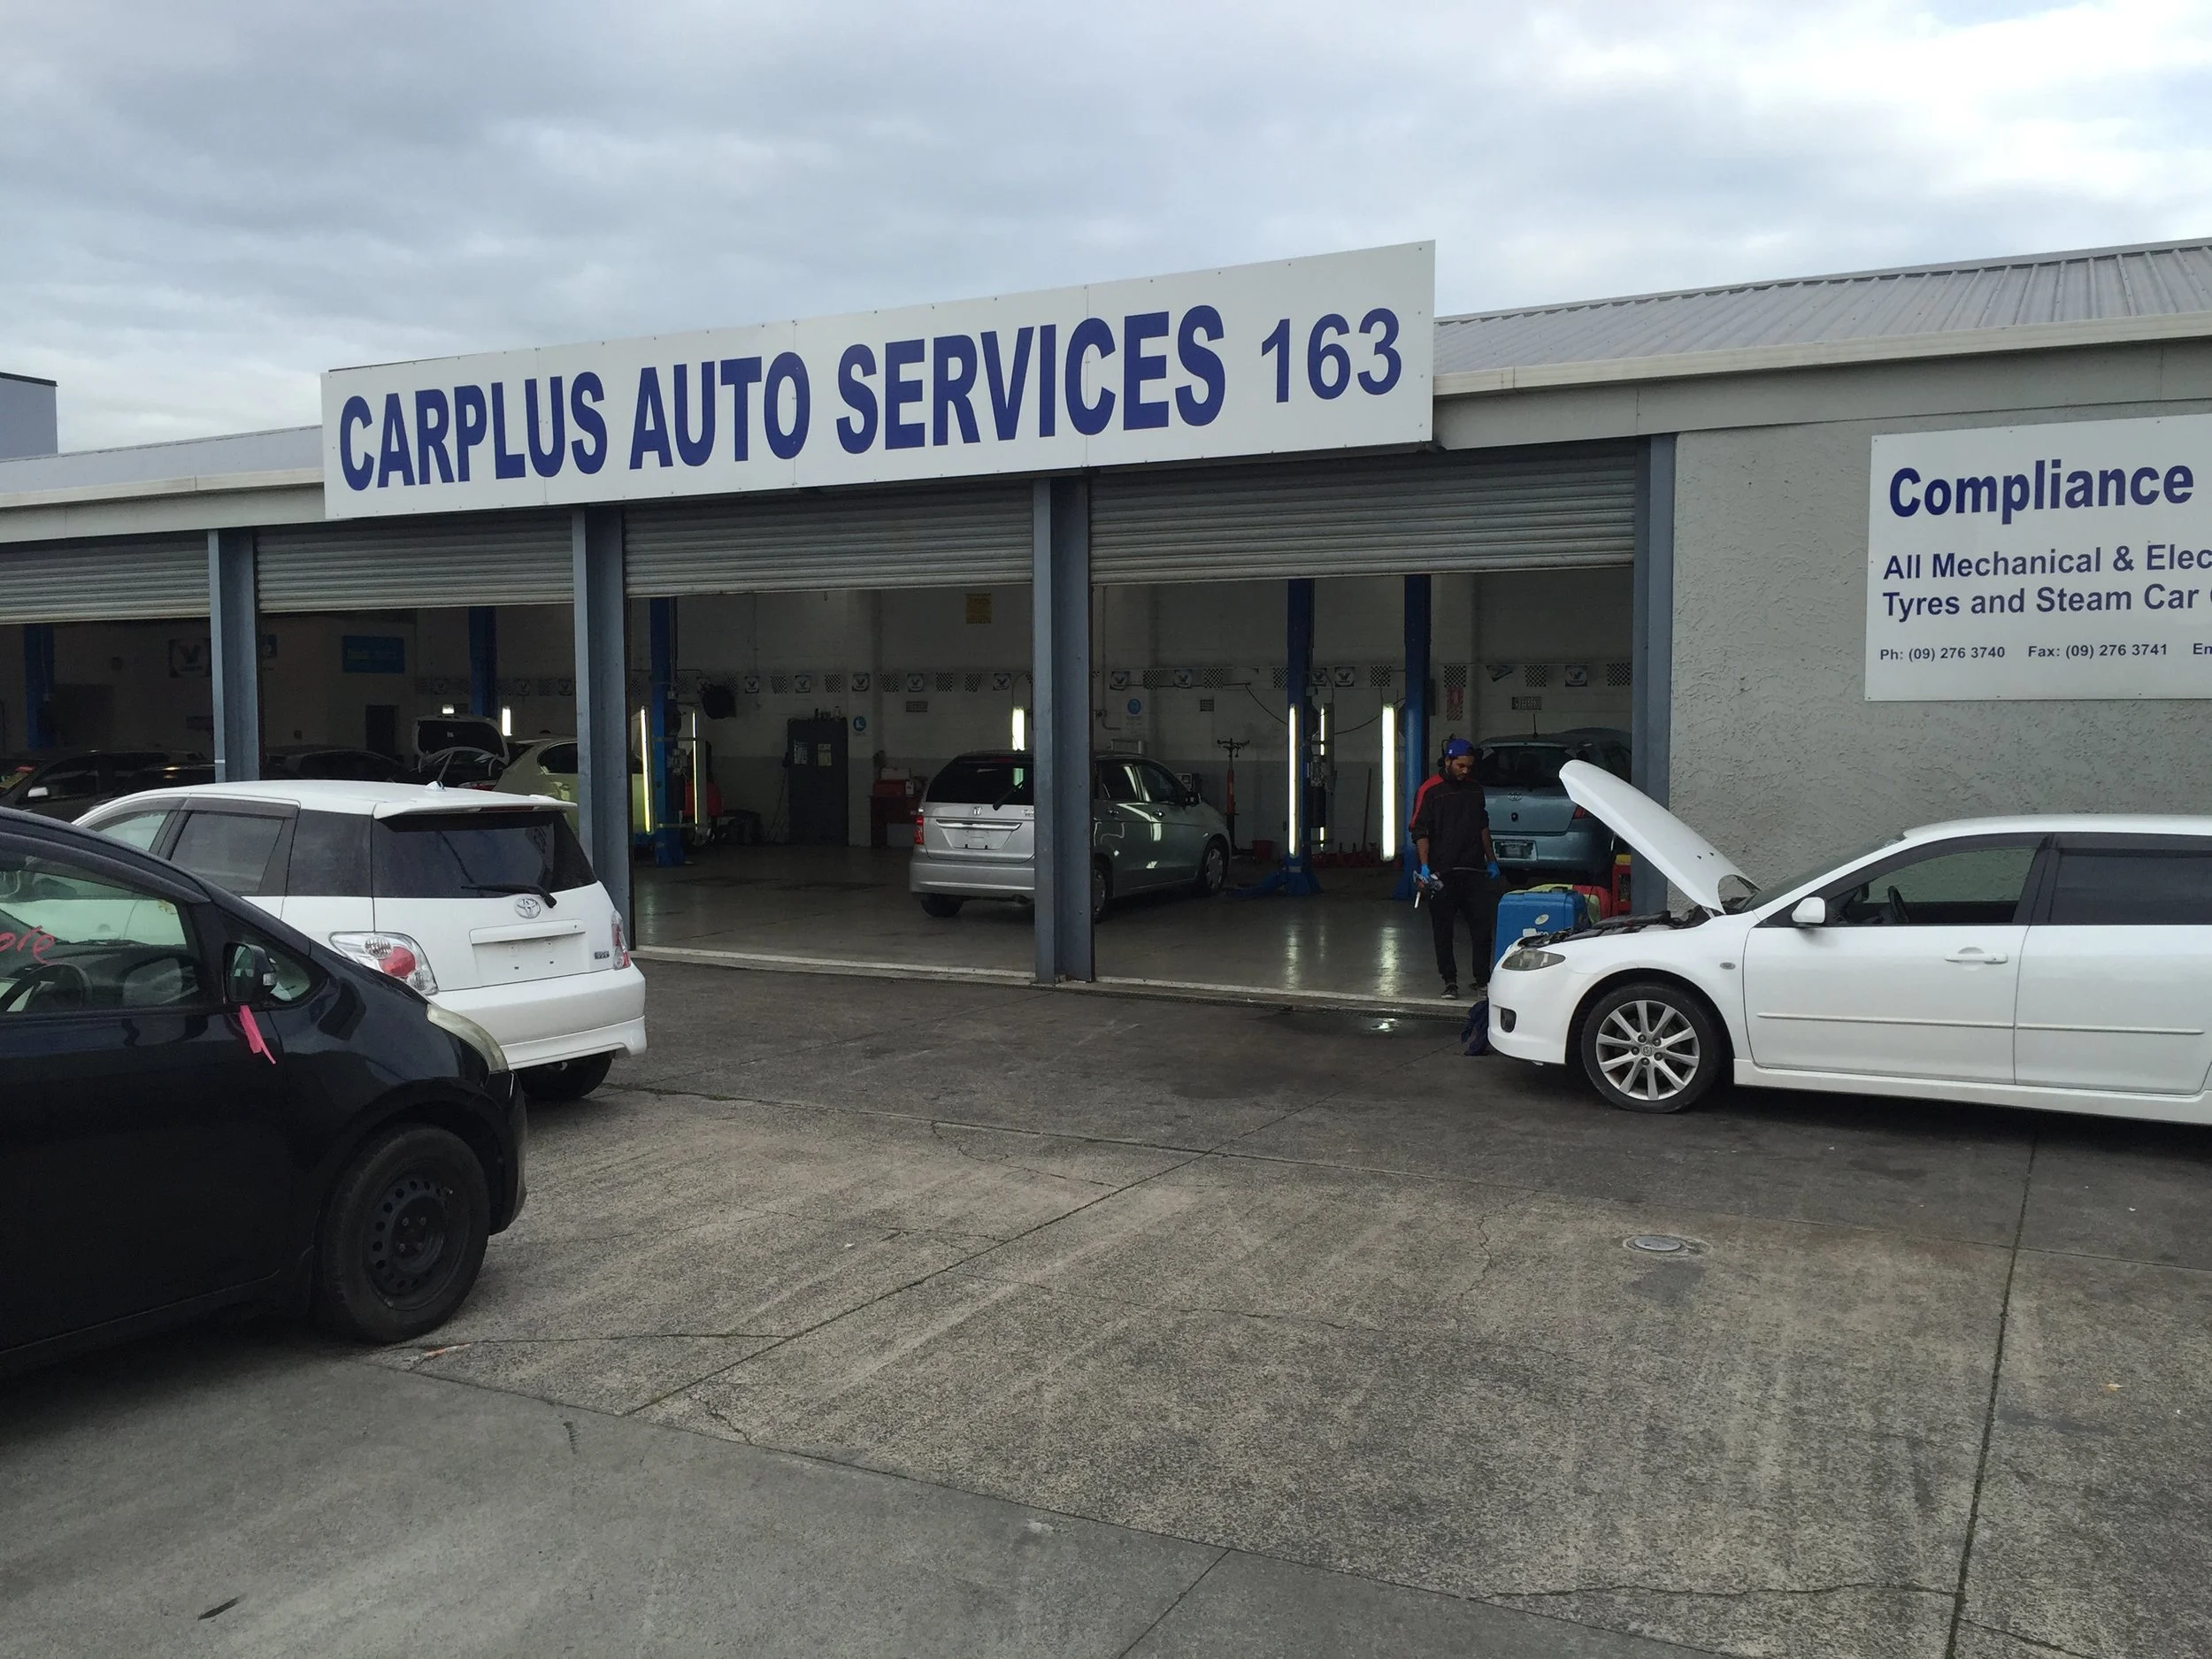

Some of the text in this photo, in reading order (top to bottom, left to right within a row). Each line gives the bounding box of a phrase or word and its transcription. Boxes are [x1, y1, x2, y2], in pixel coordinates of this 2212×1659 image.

[339, 304, 1402, 491] CARPLUS AUTO SERVICES 163
[1889, 458, 2194, 526] Compliance
[1883, 543, 2212, 580] All Mechanical & Elec
[1882, 591, 1961, 624] Tyres
[1970, 588, 2025, 615] and
[2036, 586, 2132, 613] Steam
[2144, 583, 2200, 611] Car
[1880, 649, 1904, 661] Ph:
[1909, 647, 1936, 663] (09)
[1939, 647, 1966, 659] 276
[1970, 646, 2006, 659] 3740
[2028, 645, 2062, 658] Fax:
[2065, 644, 2095, 660] (09)
[2099, 644, 2127, 657] 276
[2131, 643, 2167, 657] 3741
